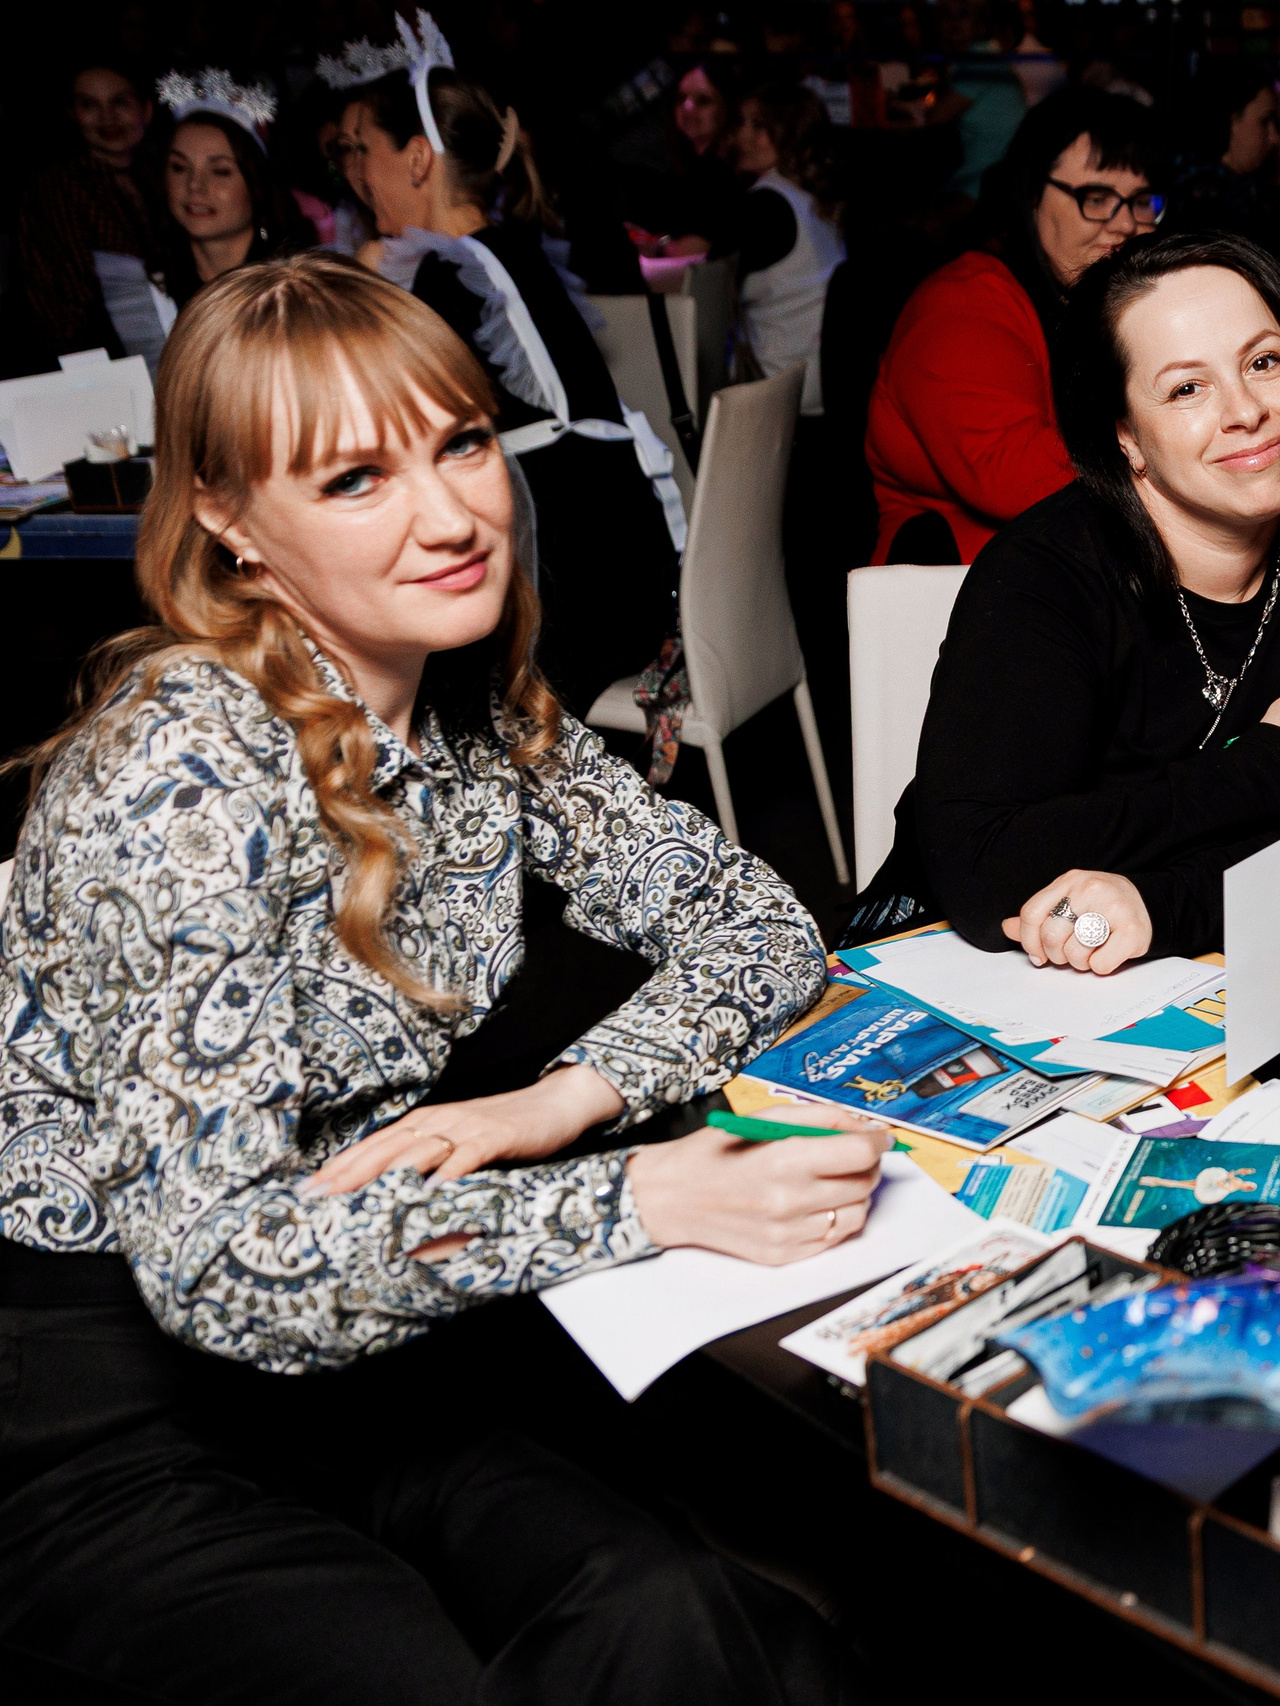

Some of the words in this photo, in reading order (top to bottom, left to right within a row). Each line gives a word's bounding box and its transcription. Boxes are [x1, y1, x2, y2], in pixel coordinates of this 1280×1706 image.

[826, 1011, 929, 1080] БАРНАЯ
[1001, 1081, 1048, 1110] ВВЕРХ
[1021, 1084, 1059, 1109] РУКИ
